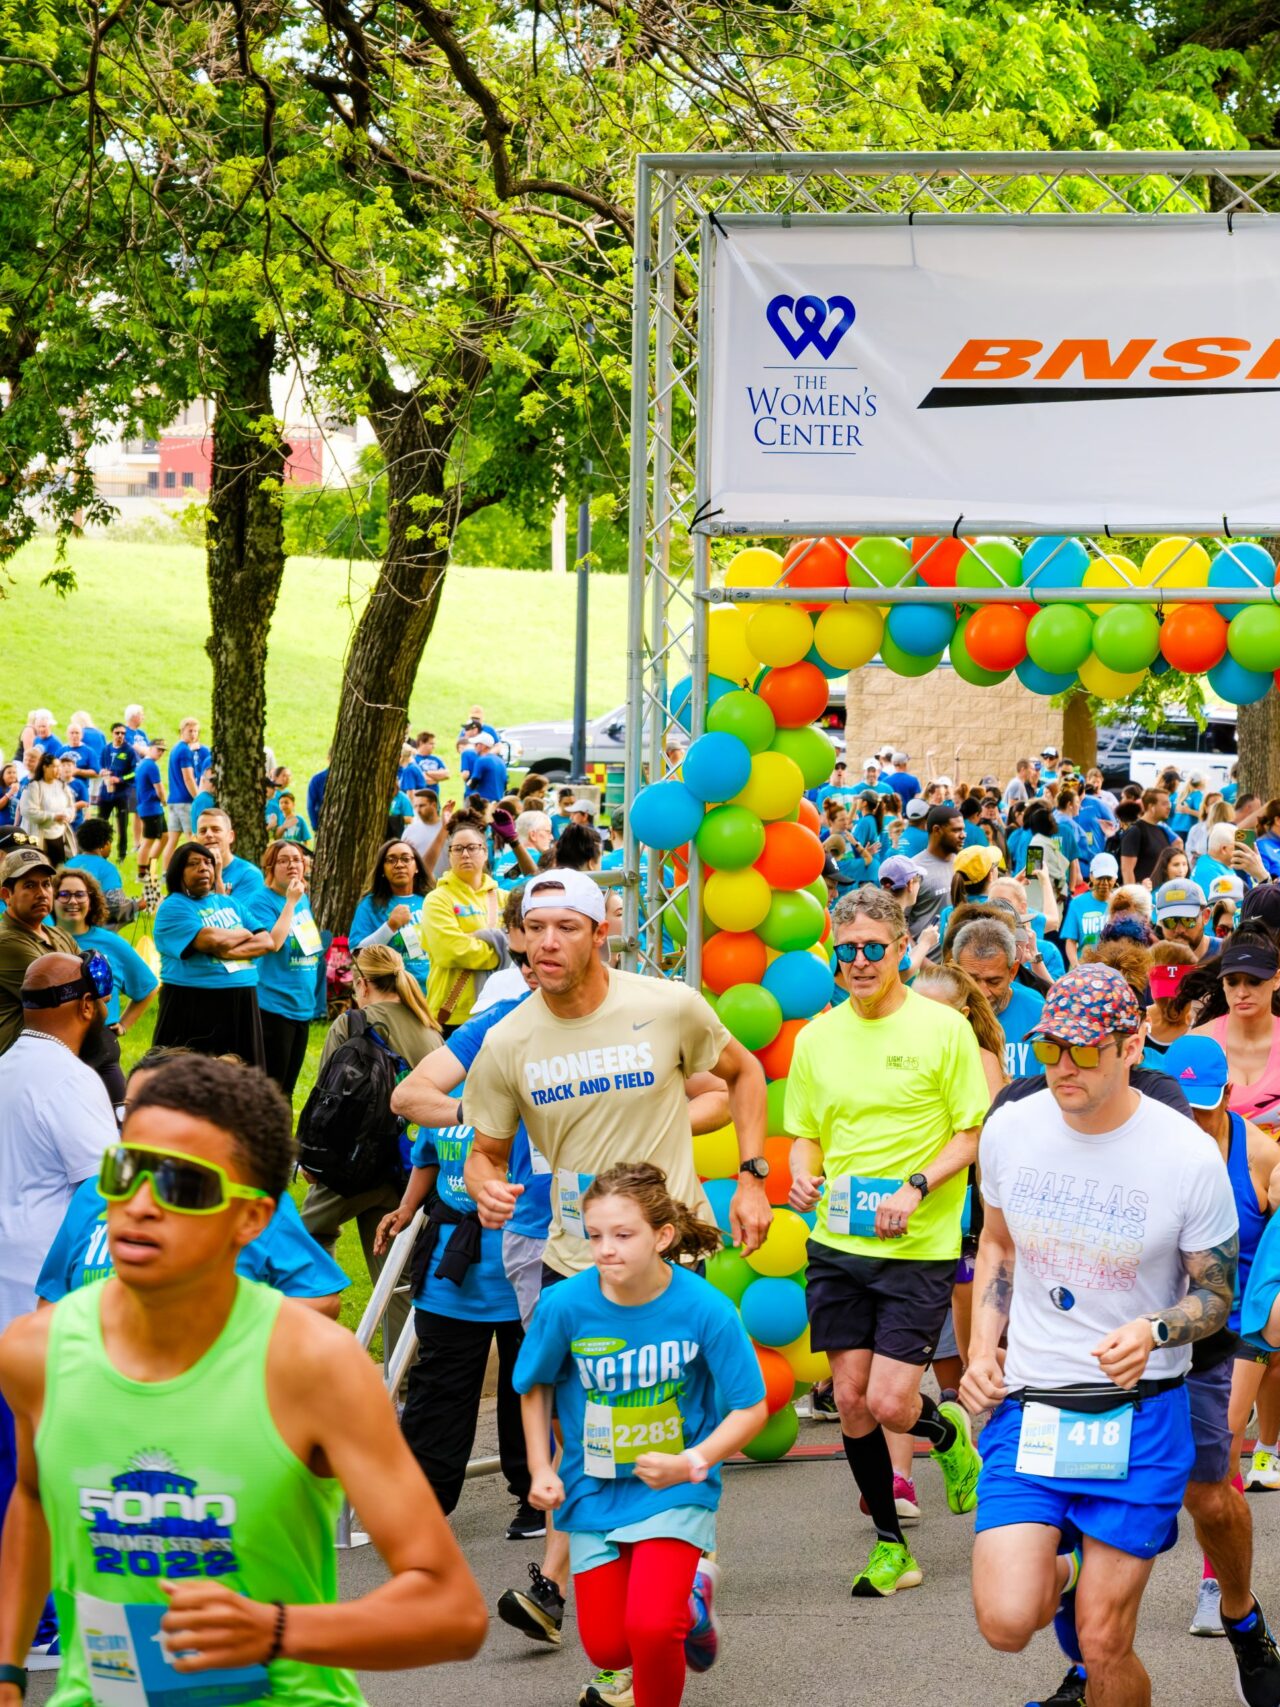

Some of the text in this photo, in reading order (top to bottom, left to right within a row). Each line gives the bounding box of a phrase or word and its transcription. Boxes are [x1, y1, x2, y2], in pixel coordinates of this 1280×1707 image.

[793, 375, 827, 390] THE
[1167, 966, 1178, 978] T
[524, 1041, 654, 1089] PIONEERS
[530, 1071, 655, 1106] TRACK AND FIELD
[1011, 1166, 1150, 1222] DALLAS
[577, 1340, 700, 1392] VCTORY
[614, 1416, 681, 1448] 2283
[1067, 1420, 1121, 1446] 418
[94, 1546, 240, 1579] 2022
